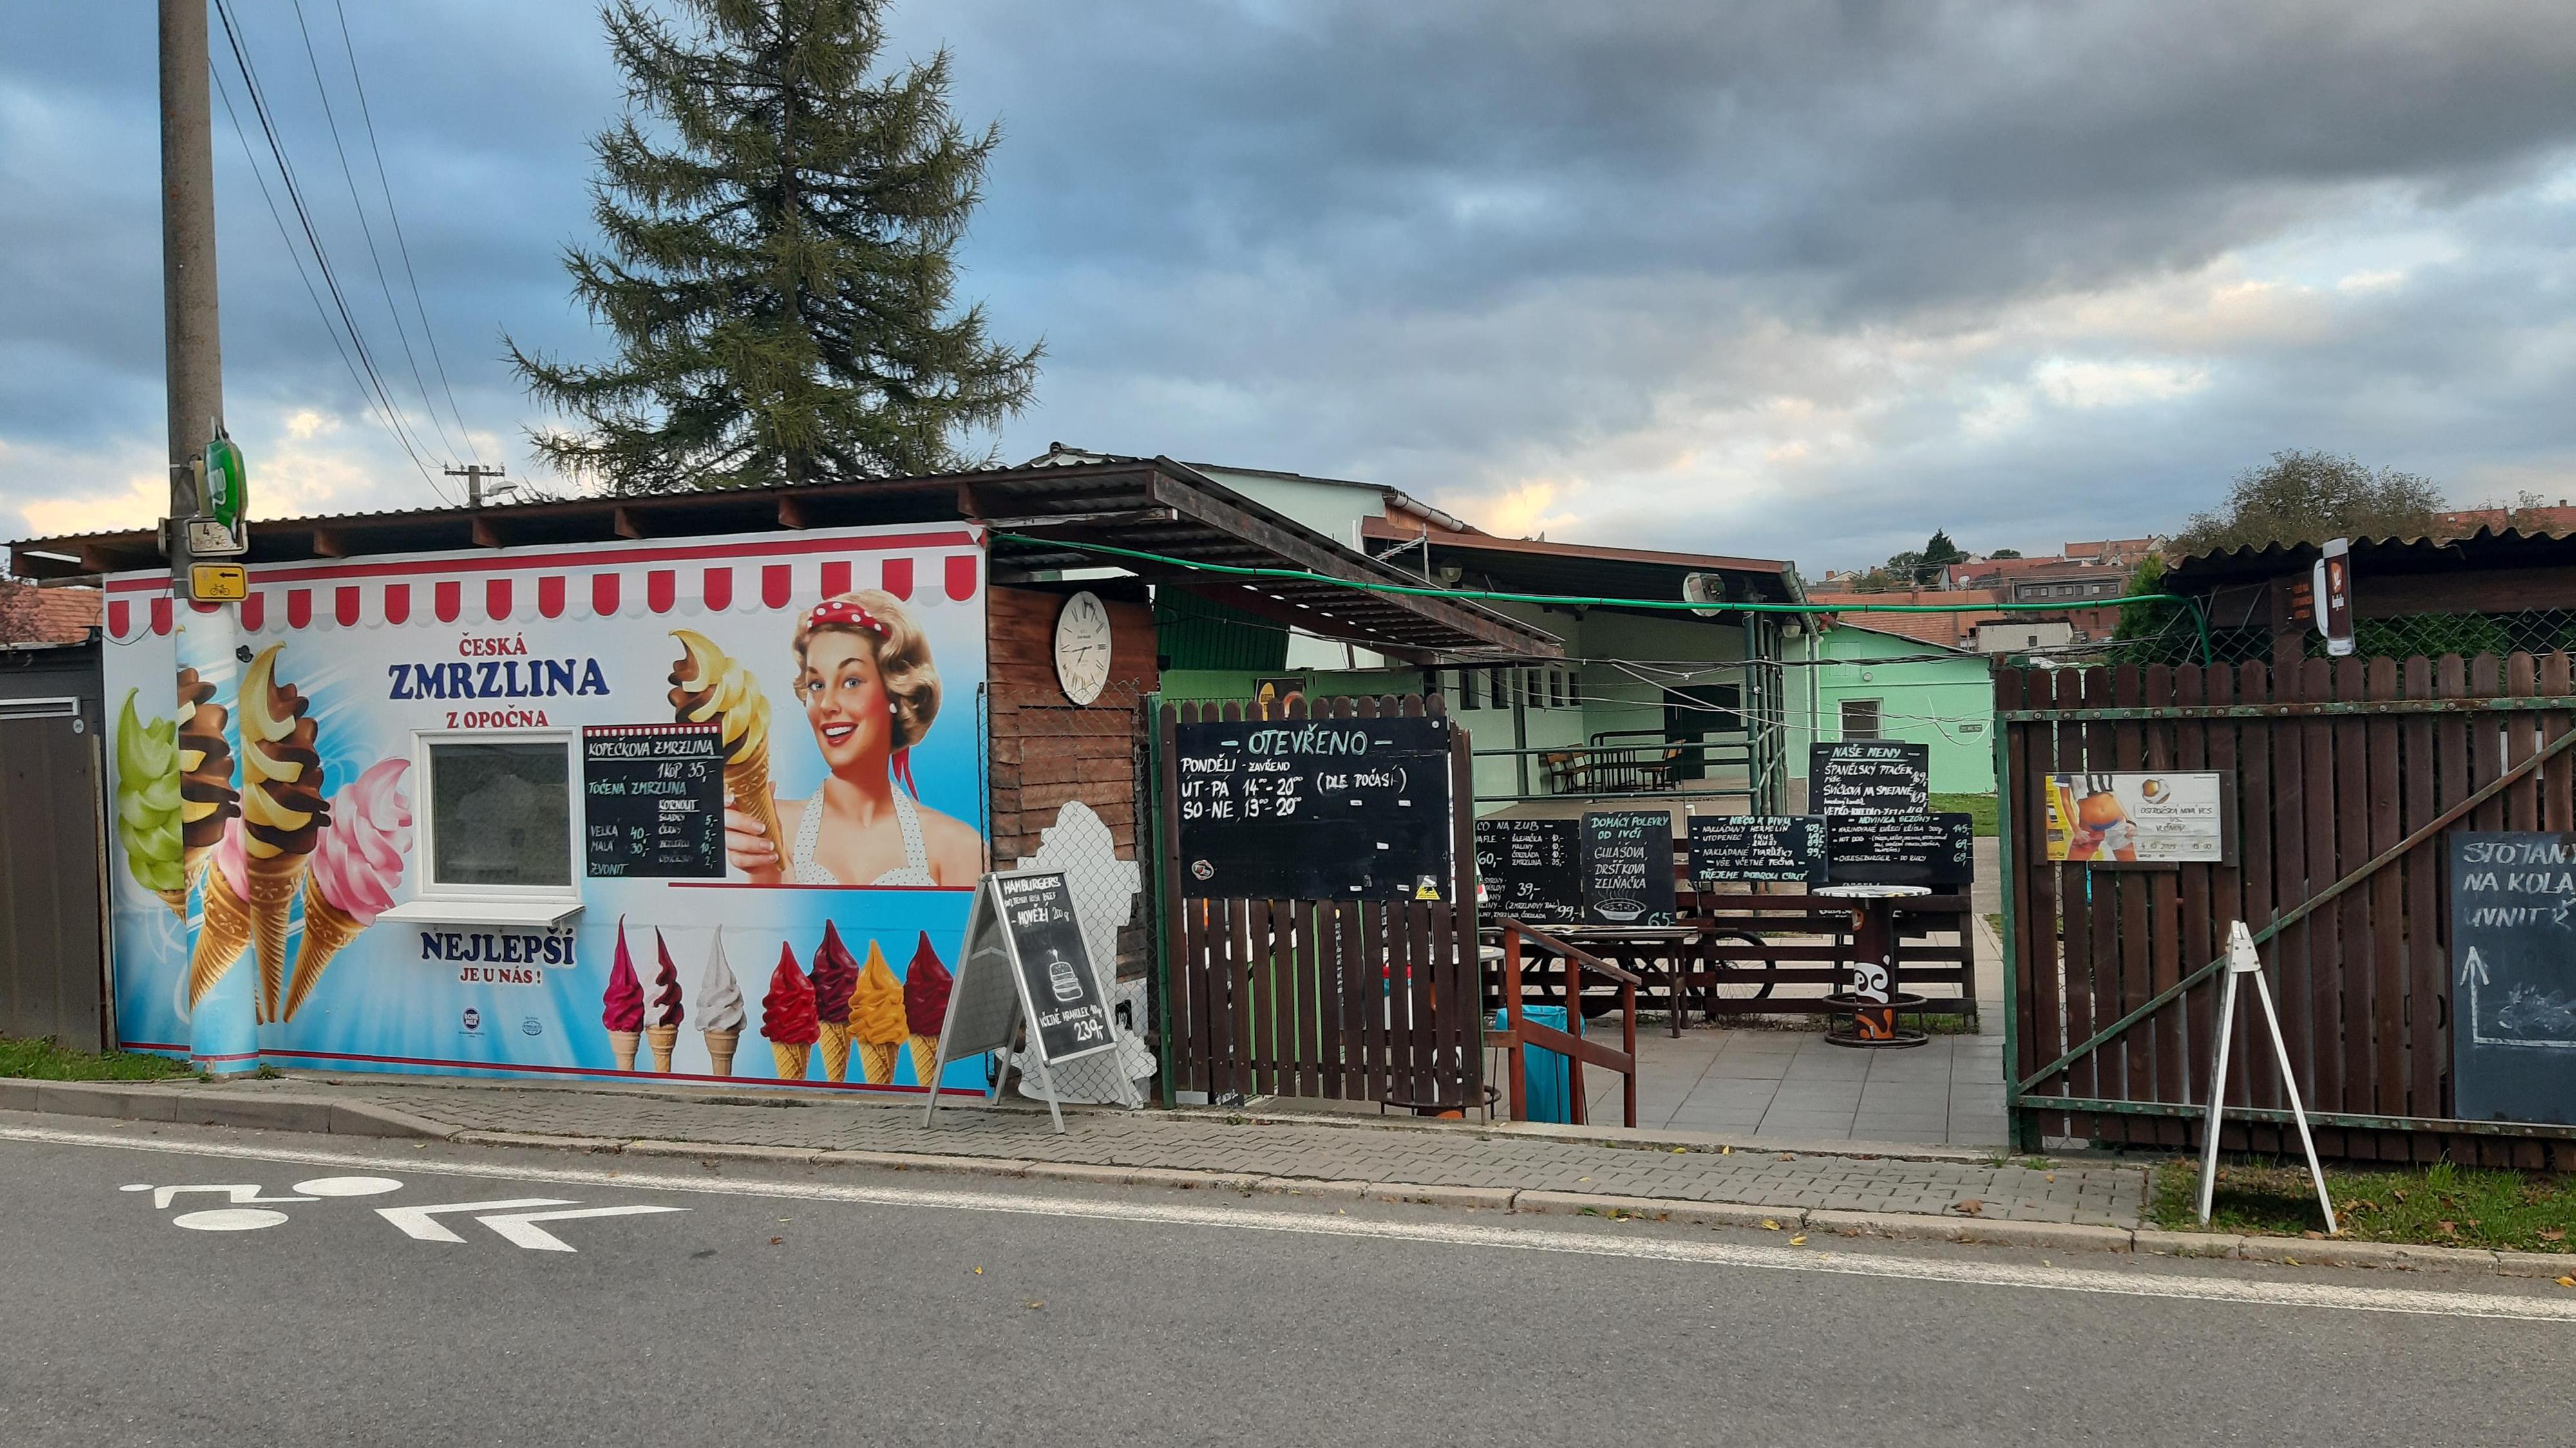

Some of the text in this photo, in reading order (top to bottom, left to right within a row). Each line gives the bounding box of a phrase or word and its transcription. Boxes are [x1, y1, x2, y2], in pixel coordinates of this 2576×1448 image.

[203, 524, 210, 536] 4
[460, 632, 527, 656] ČESKÁ
[389, 658, 610, 700] ZMRZLINA
[446, 704, 549, 728] Z OPOČNA
[589, 737, 715, 757] KOPEČKOVÁ ZMRZLINA
[1248, 723, 1368, 755] OTEVŘENO
[1180, 749, 1291, 773] PONDĚLÍ ZAVŘENO
[1832, 744, 1901, 758] NAŠE MENY
[589, 775, 687, 795] TOČENÁ ZMRZLINA
[1477, 821, 1539, 831] CO NA ZUB
[1767, 816, 1791, 826] PIVU
[1598, 831, 1611, 840] OD
[591, 862, 629, 875] ZVONIT
[1003, 876, 1061, 895] HAMBURGERS
[2463, 872, 2574, 894] NA KOLA
[421, 927, 574, 964] NEJLEPŠÍ
[460, 968, 479, 981] JE
[484, 968, 494, 982] U
